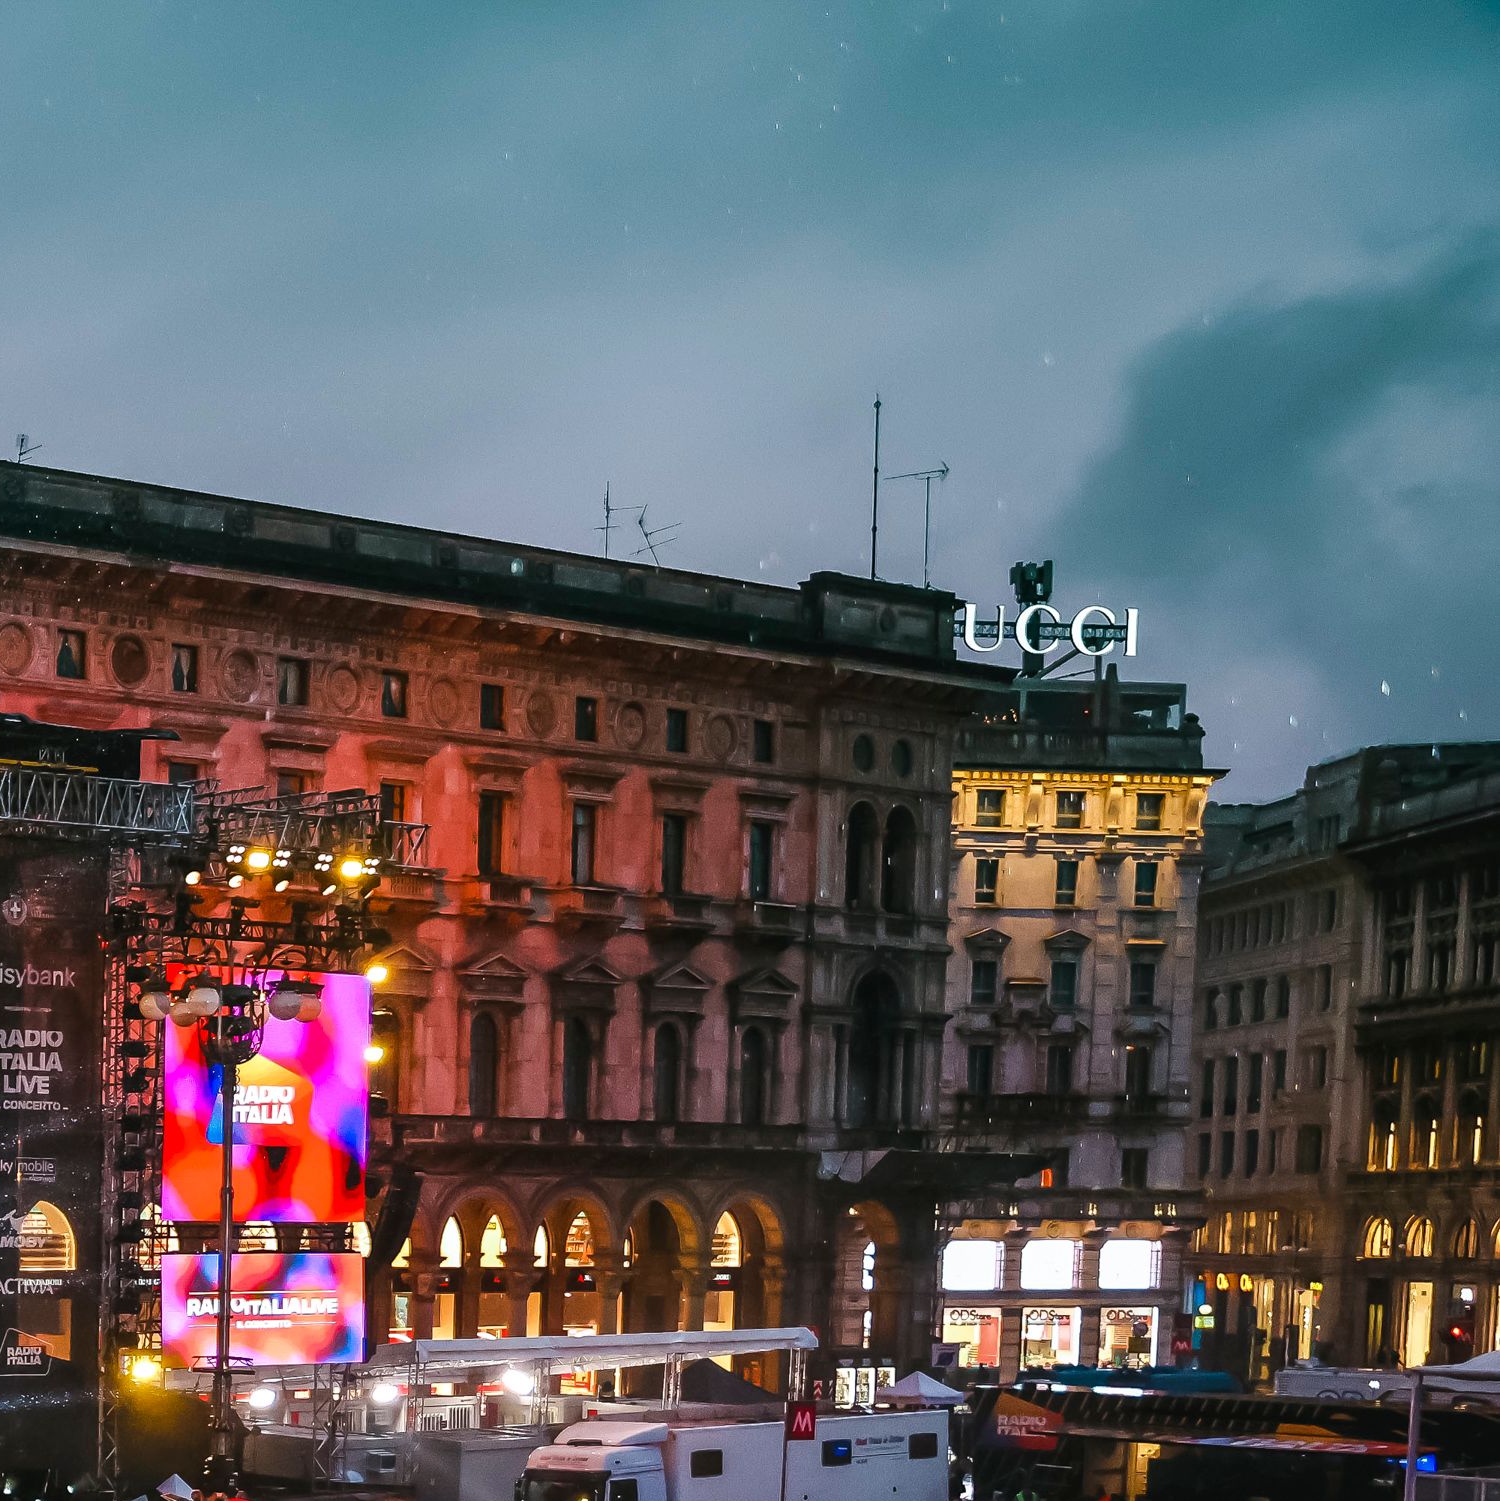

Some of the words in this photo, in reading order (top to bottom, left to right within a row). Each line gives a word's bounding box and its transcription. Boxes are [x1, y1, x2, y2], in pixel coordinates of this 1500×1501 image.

[0, 962, 76, 988] isybank
[3, 1074, 50, 1095] LIVE
[3, 1099, 61, 1111] CONCERTO
[232, 1104, 295, 1125] ITALIA
[18, 1160, 55, 1172] mobile
[7, 1346, 42, 1356] RADIO
[6, 1356, 42, 1366] ITALIA
[792, 1411, 812, 1432] M
[997, 1414, 1047, 1427] RADIO
